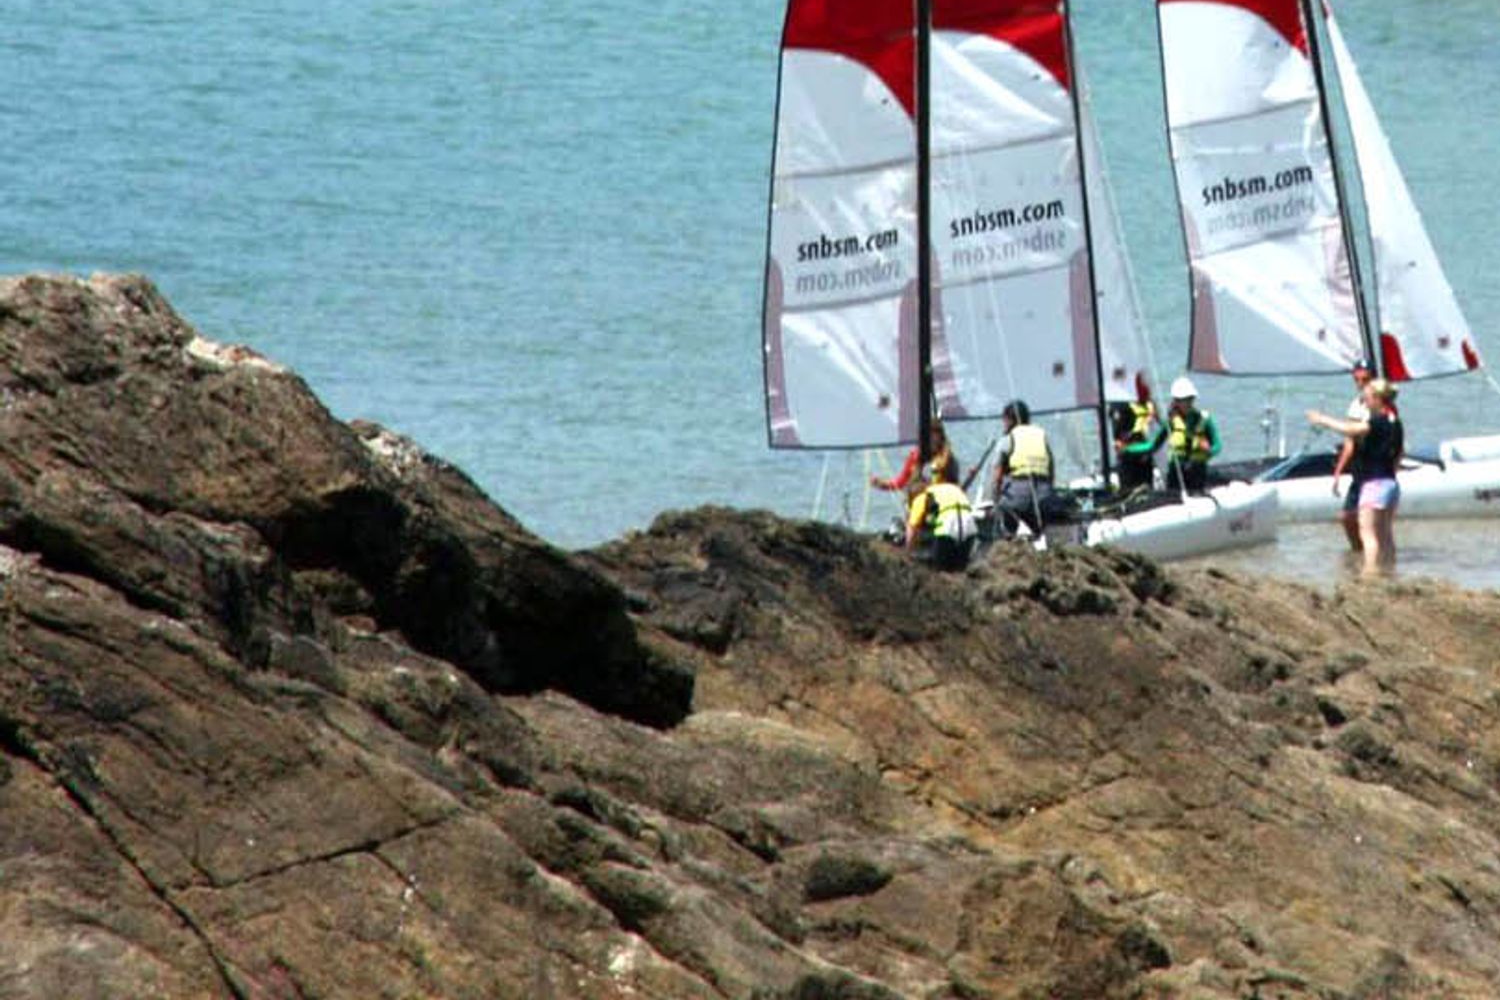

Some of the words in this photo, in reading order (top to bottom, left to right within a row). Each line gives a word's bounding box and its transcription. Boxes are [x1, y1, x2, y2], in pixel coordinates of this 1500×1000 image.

[1202, 166, 1313, 206] snbsm.com
[950, 200, 1065, 239] snbsm.com
[797, 229, 899, 263] snbsm.com
